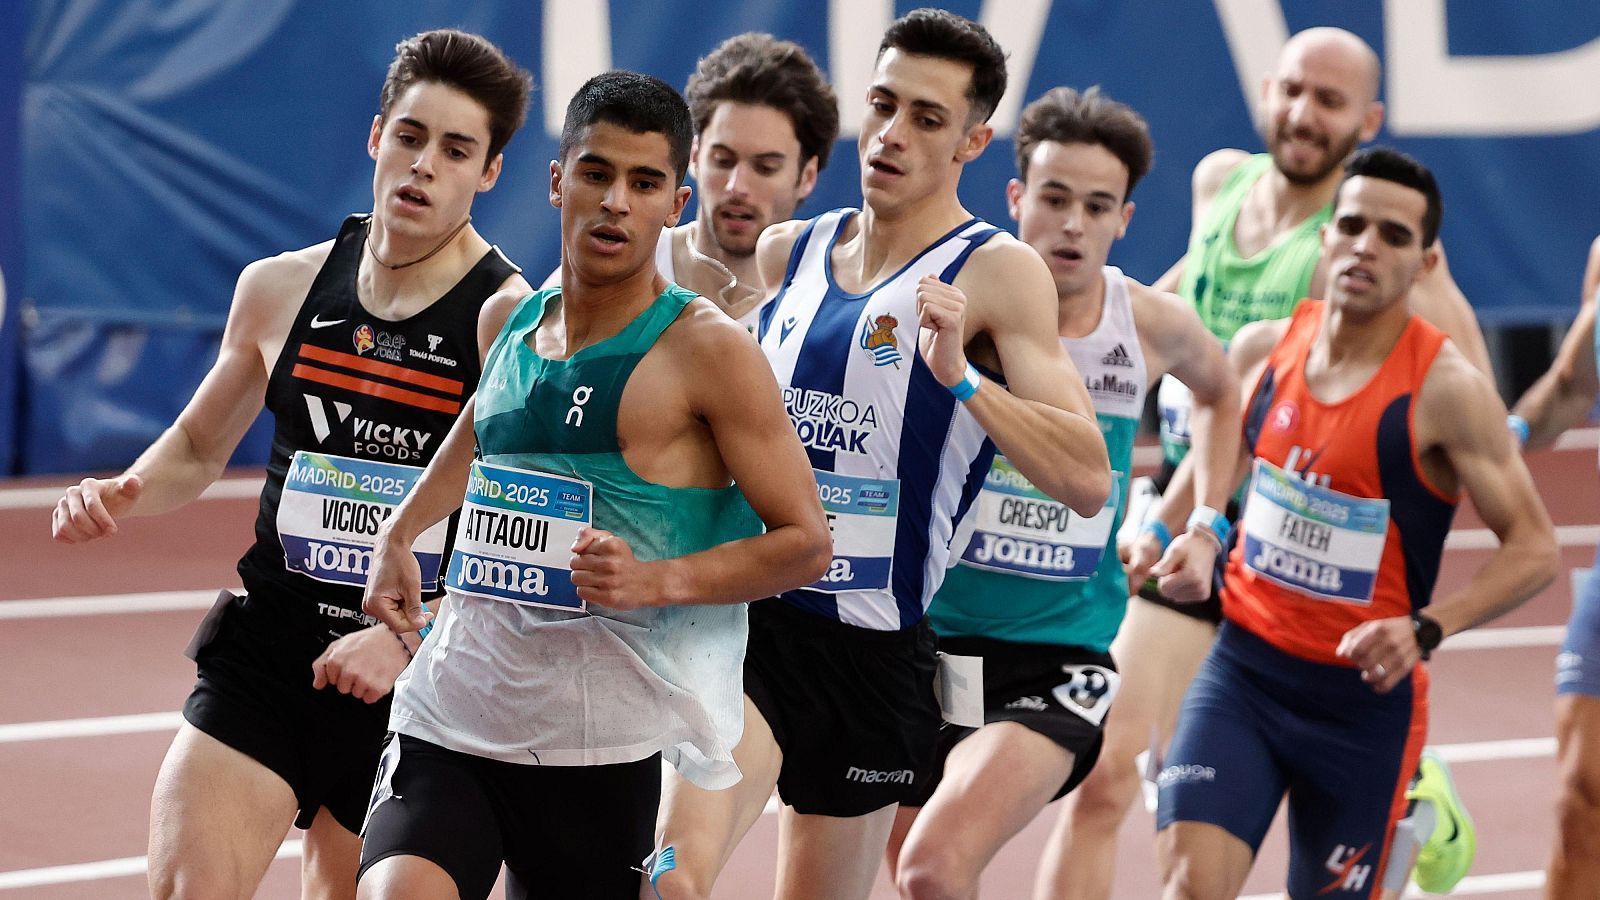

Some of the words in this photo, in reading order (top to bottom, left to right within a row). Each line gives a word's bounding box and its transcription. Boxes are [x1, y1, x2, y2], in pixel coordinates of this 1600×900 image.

[783, 387, 878, 429] PUZKOA
[353, 417, 431, 450] VICKY
[792, 418, 868, 455] OLAK
[354, 442, 421, 460] FOODS
[292, 465, 356, 489] MADRID
[359, 475, 406, 496] 2025
[468, 476, 501, 498] DRID
[505, 483, 550, 507] 2025
[562, 492, 581, 502] TEAM
[865, 490, 885, 498] TEAM
[465, 507, 549, 553] ATTAOUI
[1000, 497, 1069, 533] CRESPO
[1278, 511, 1332, 552] FATEH
[304, 541, 374, 575] Jom
[975, 533, 1076, 571] Joma
[1253, 540, 1343, 591] Joma
[457, 554, 549, 596] Joma
[318, 602, 381, 626] TOP4R
[846, 766, 914, 784] macron
